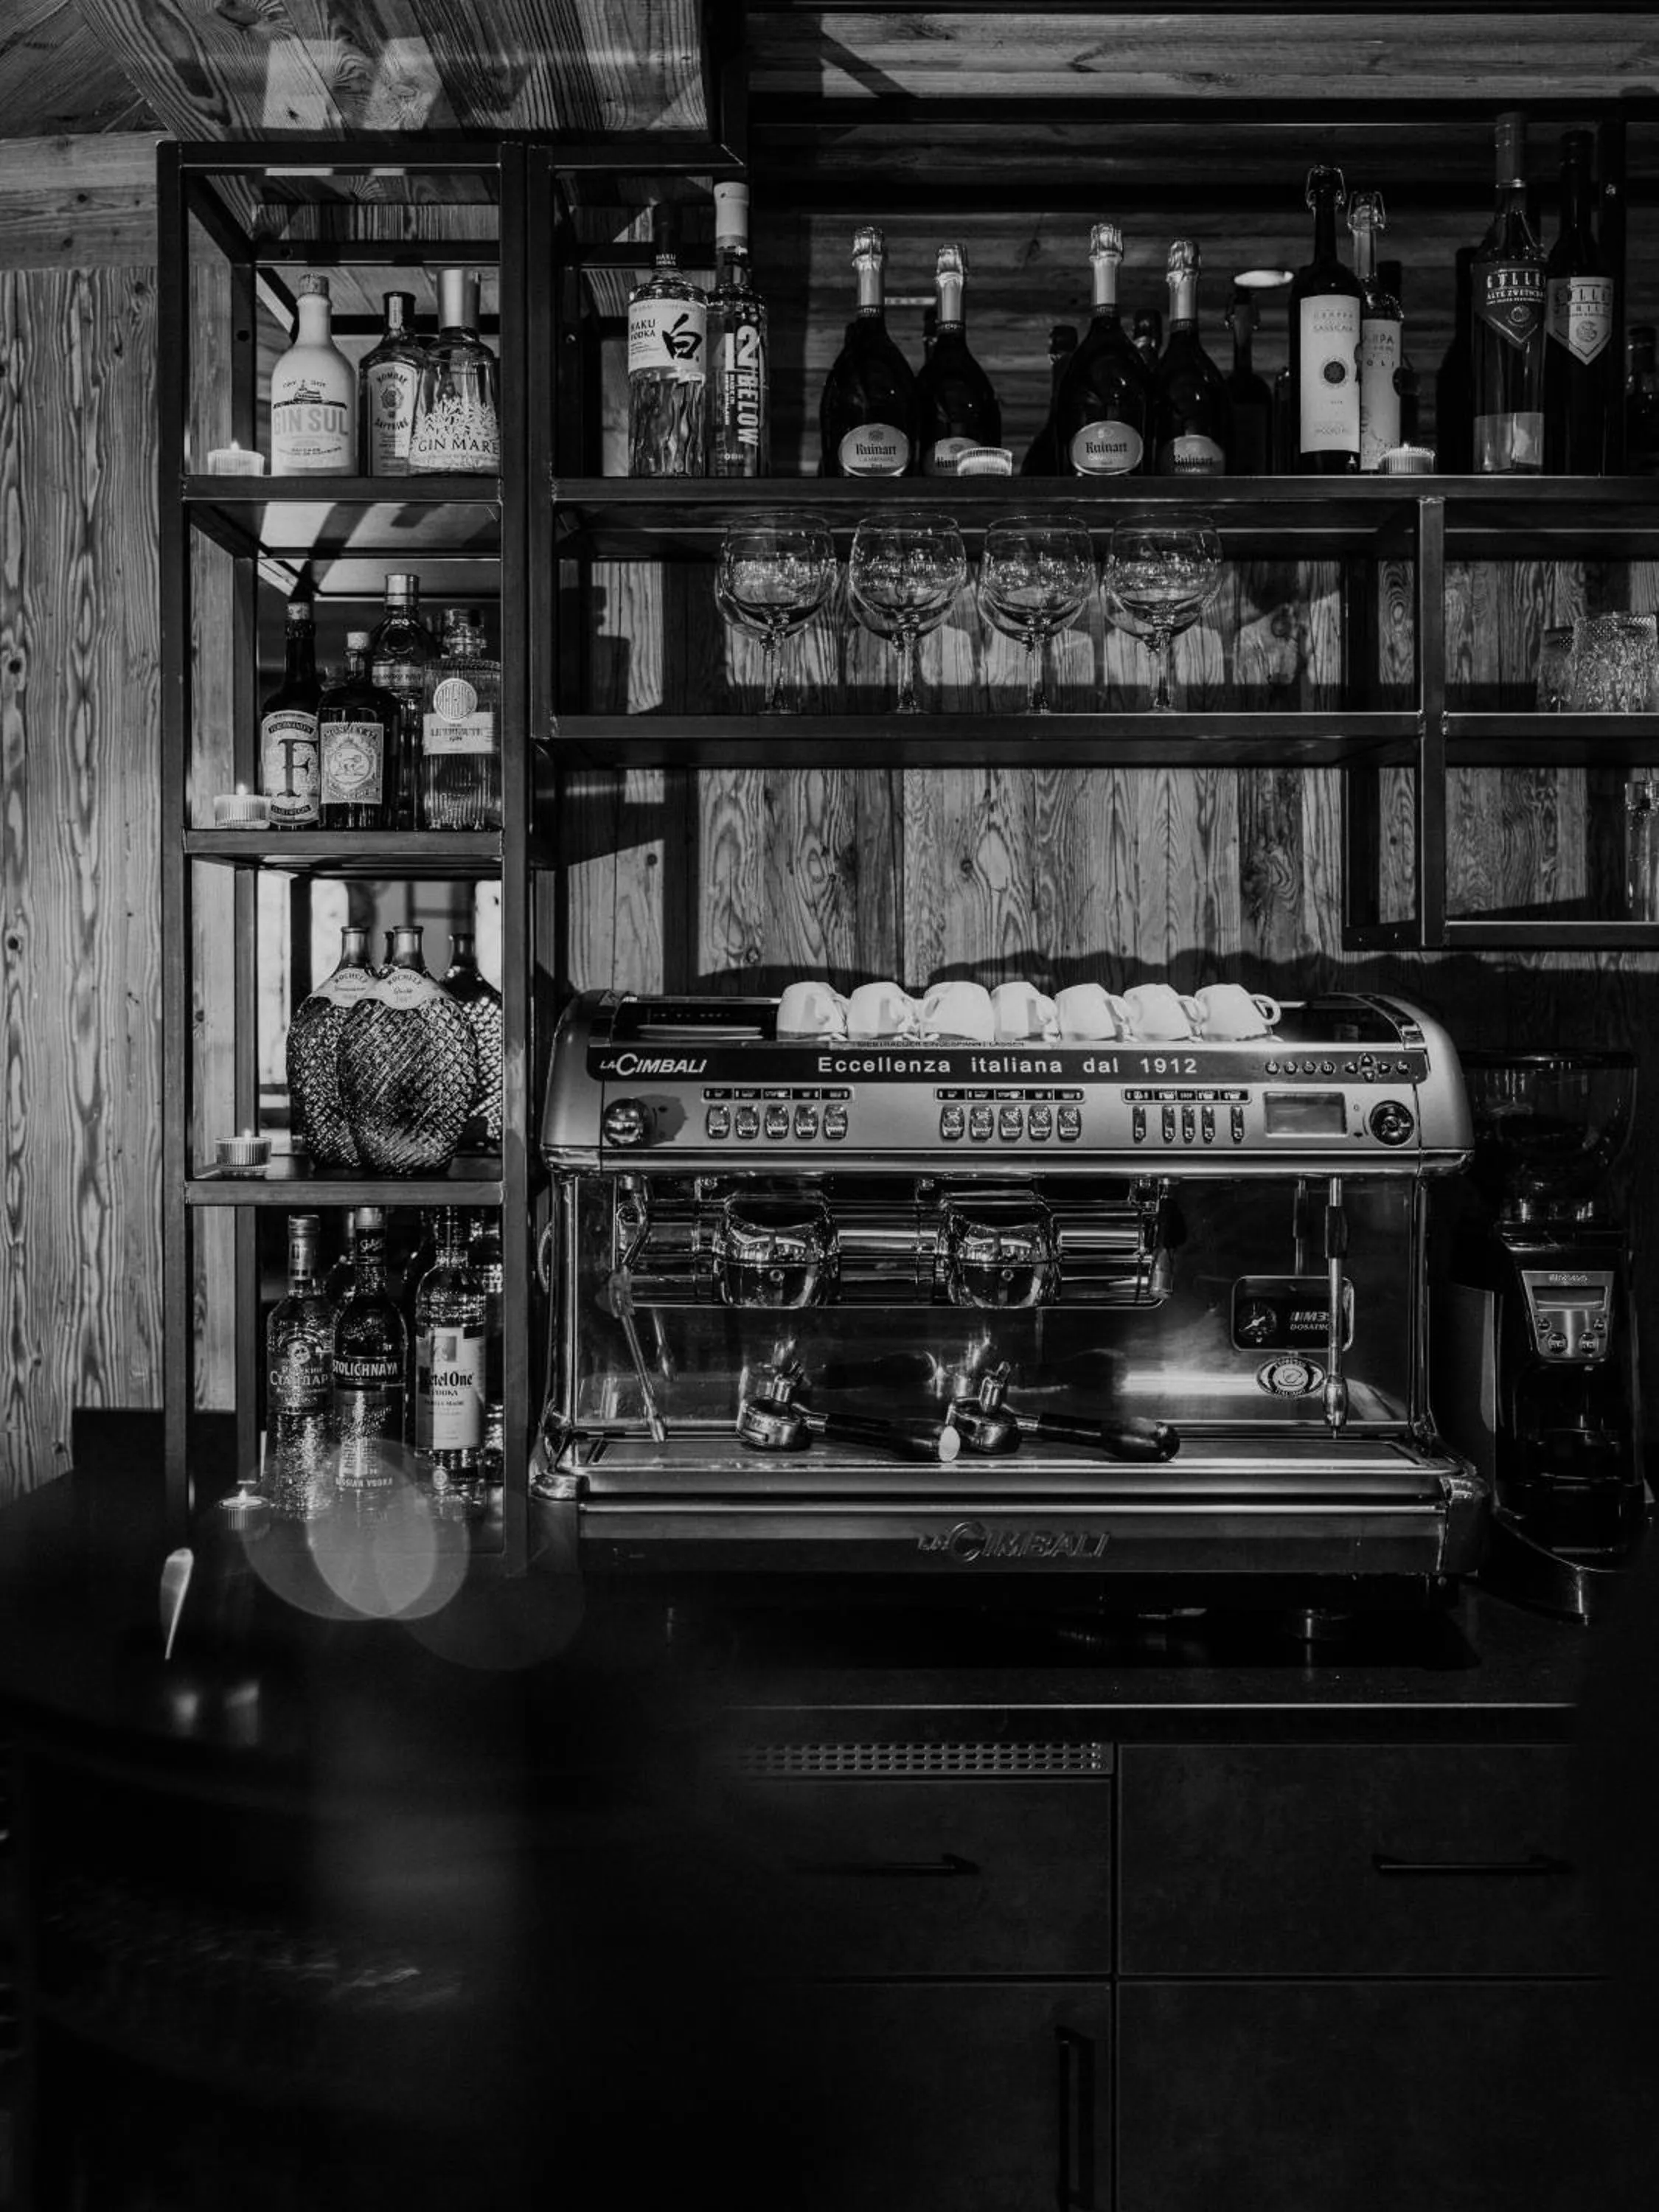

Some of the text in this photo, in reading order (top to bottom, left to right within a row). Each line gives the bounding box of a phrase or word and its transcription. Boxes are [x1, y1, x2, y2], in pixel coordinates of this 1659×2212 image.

[274, 406, 349, 435] GIN SUL
[418, 439, 500, 454] GIN MARE
[855, 443, 897, 455] Ruinart
[1085, 441, 1127, 454] Ruinart
[599, 1053, 708, 1077] LA CIMBALI
[818, 1056, 1198, 1074] Eccellenza italiana dal 1912
[449, 1371, 473, 1386] One
